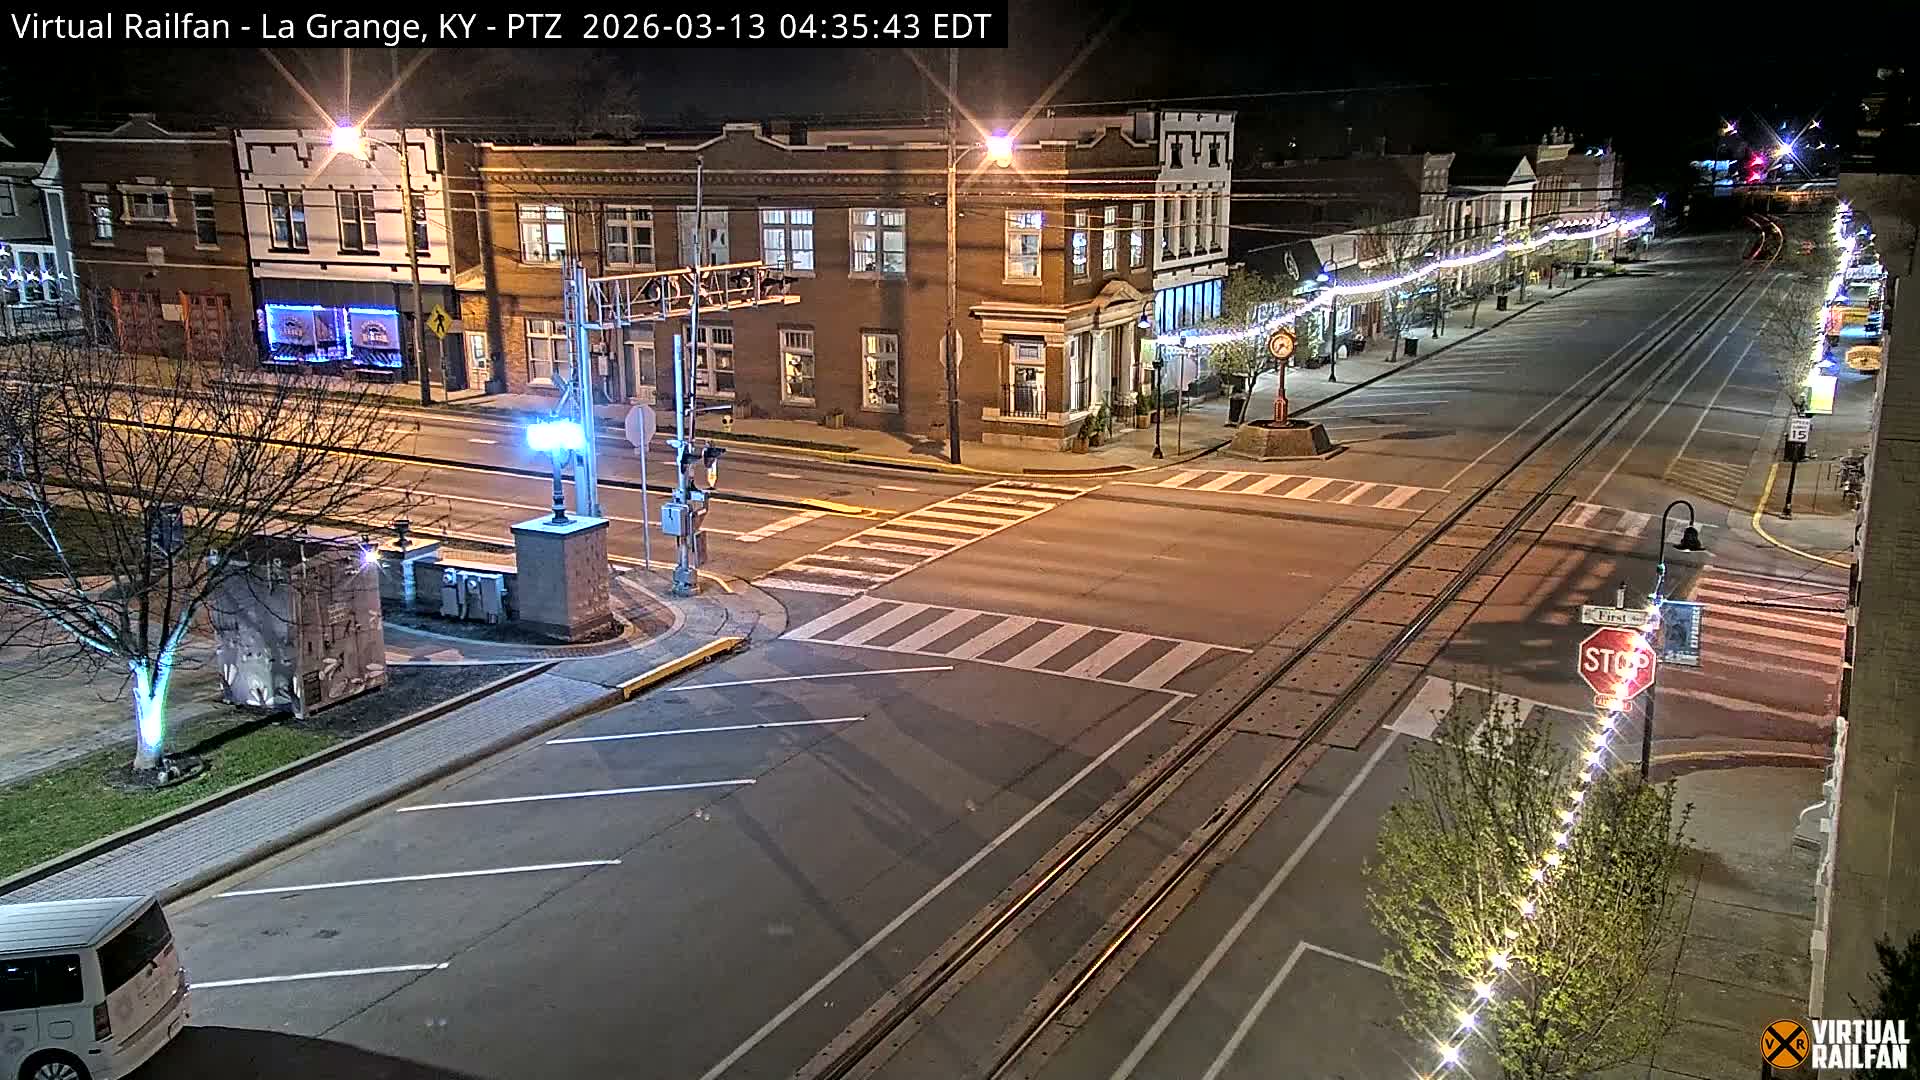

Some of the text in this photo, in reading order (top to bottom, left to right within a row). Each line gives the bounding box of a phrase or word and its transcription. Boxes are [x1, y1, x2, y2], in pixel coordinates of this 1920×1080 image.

[1793, 430, 1807, 440] 15
[1599, 611, 1626, 622] First
[1584, 647, 1650, 678] STOP
